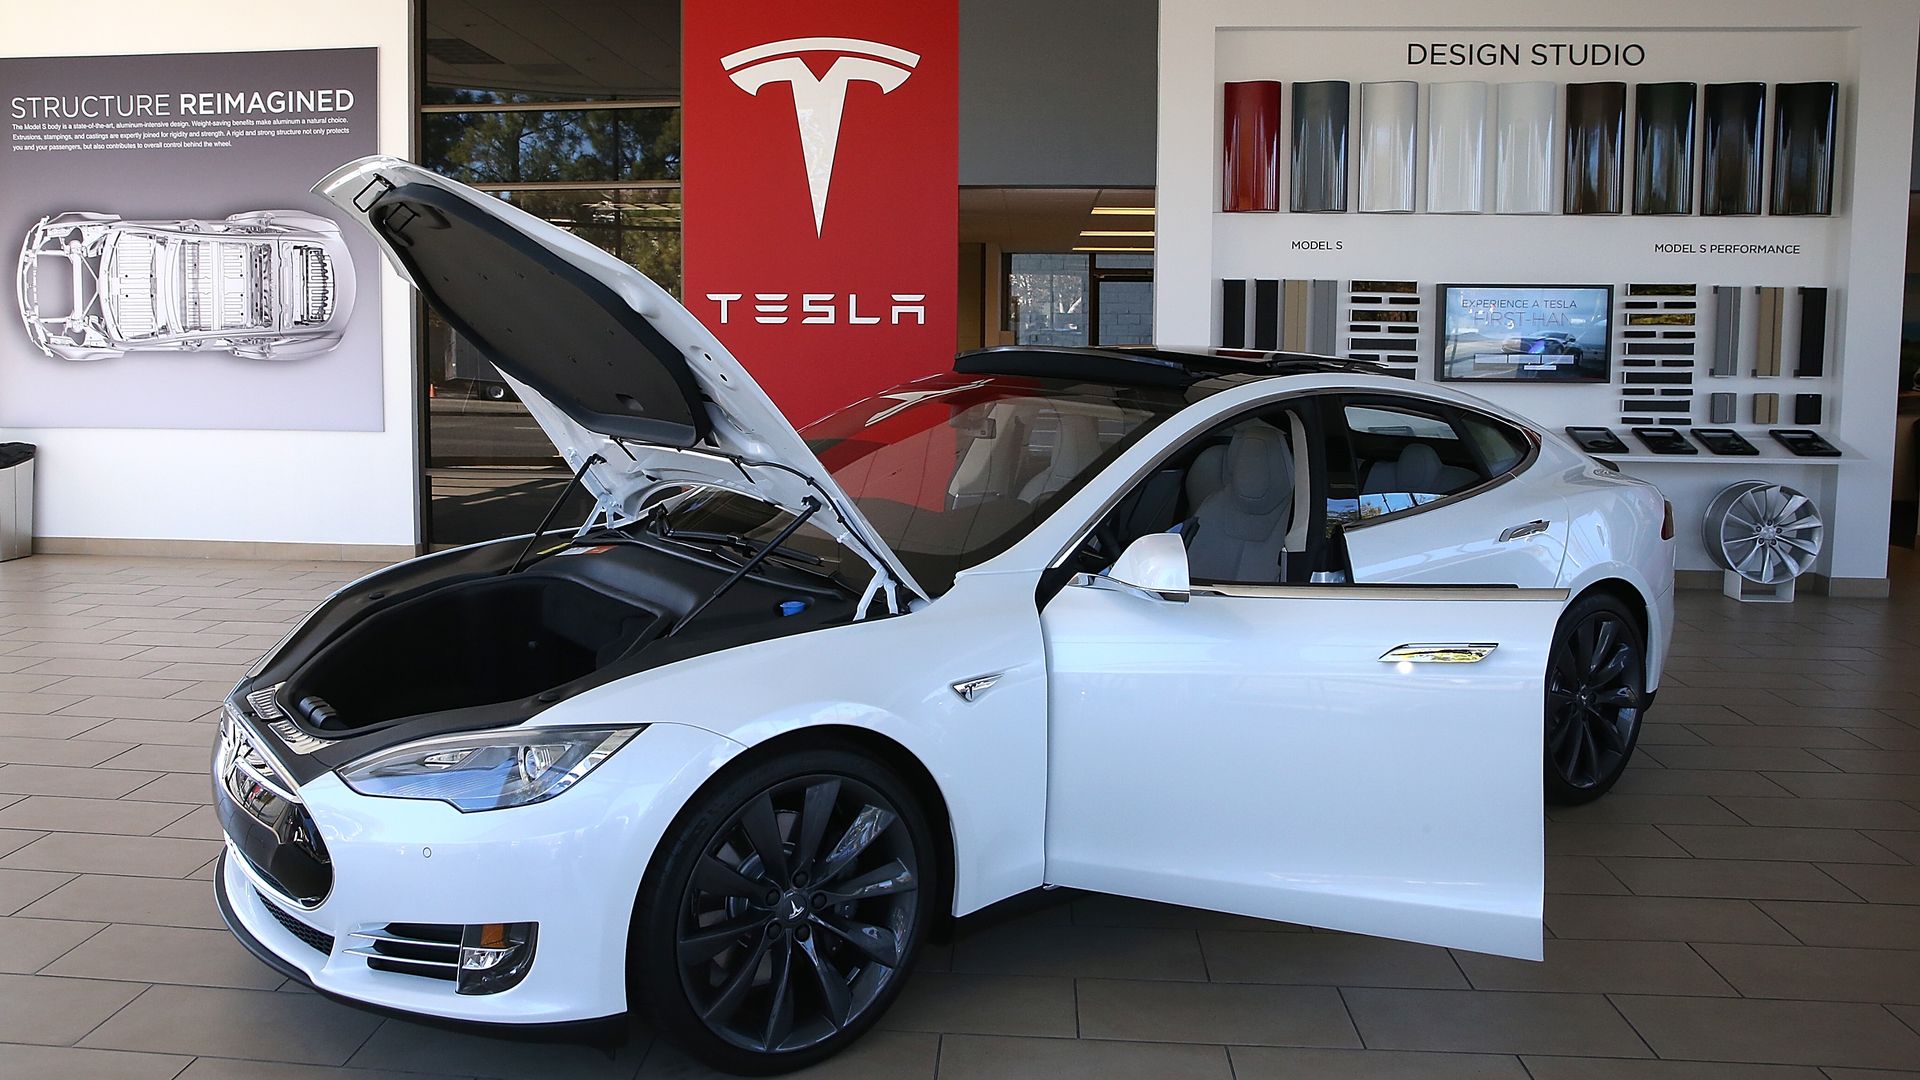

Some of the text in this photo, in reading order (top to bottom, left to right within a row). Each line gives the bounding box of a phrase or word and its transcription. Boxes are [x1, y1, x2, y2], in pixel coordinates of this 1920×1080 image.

[1407, 43, 1646, 67] DESIGN STUDIO
[11, 90, 354, 118] STRUCTURE REIMAGINED
[48, 123, 61, 131] body
[116, 121, 169, 129] aluminum-intensive
[191, 120, 231, 128] Weight-saving
[120, 132, 142, 140] expertly
[170, 131, 189, 139] rigidity
[232, 130, 245, 138] rigid
[257, 129, 276, 137] strong
[313, 128, 325, 136] only
[326, 127, 350, 135] protects
[36, 144, 48, 152] your
[1291, 240, 1343, 250] MODEL S
[1655, 244, 1801, 255] MODEL S PERFORMANCE
[705, 292, 926, 325] TESLA
[1462, 299, 1578, 309] EXPERIENCE A TESLA
